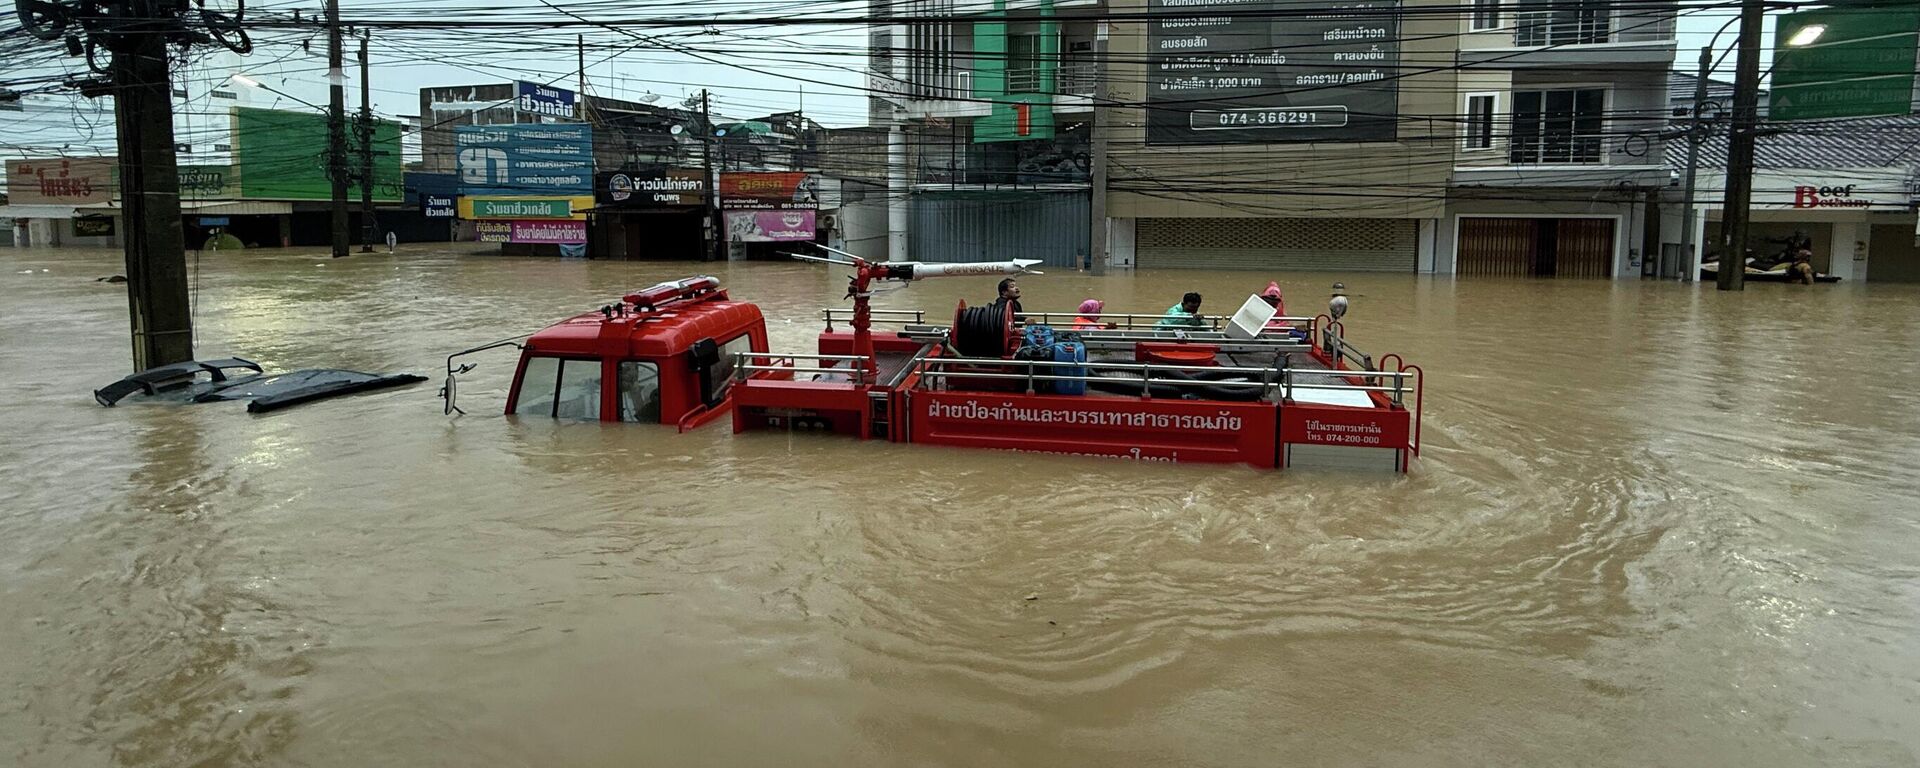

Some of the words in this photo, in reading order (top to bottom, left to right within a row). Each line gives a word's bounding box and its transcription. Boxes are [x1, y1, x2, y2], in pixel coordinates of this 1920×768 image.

[1323, 26, 1386, 40] เสริมหน้าอก
[1161, 36, 1208, 49] ลบรอยสัก
[1208, 78, 1238, 90] 1,000
[1241, 77, 1262, 88] บาท
[535, 85, 559, 99] ร้านยา
[1220, 111, 1317, 125] 074-366291
[459, 147, 509, 185] ยา
[427, 196, 451, 206] ร้านยา
[928, 399, 1242, 431] ฝ่ายป้องกันและบรรเทาสาธารณภัย
[1305, 420, 1382, 434] ใช้ในราชการเท่านั้น
[1306, 431, 1323, 441] โทร.
[1326, 434, 1380, 444] 074-200-000
